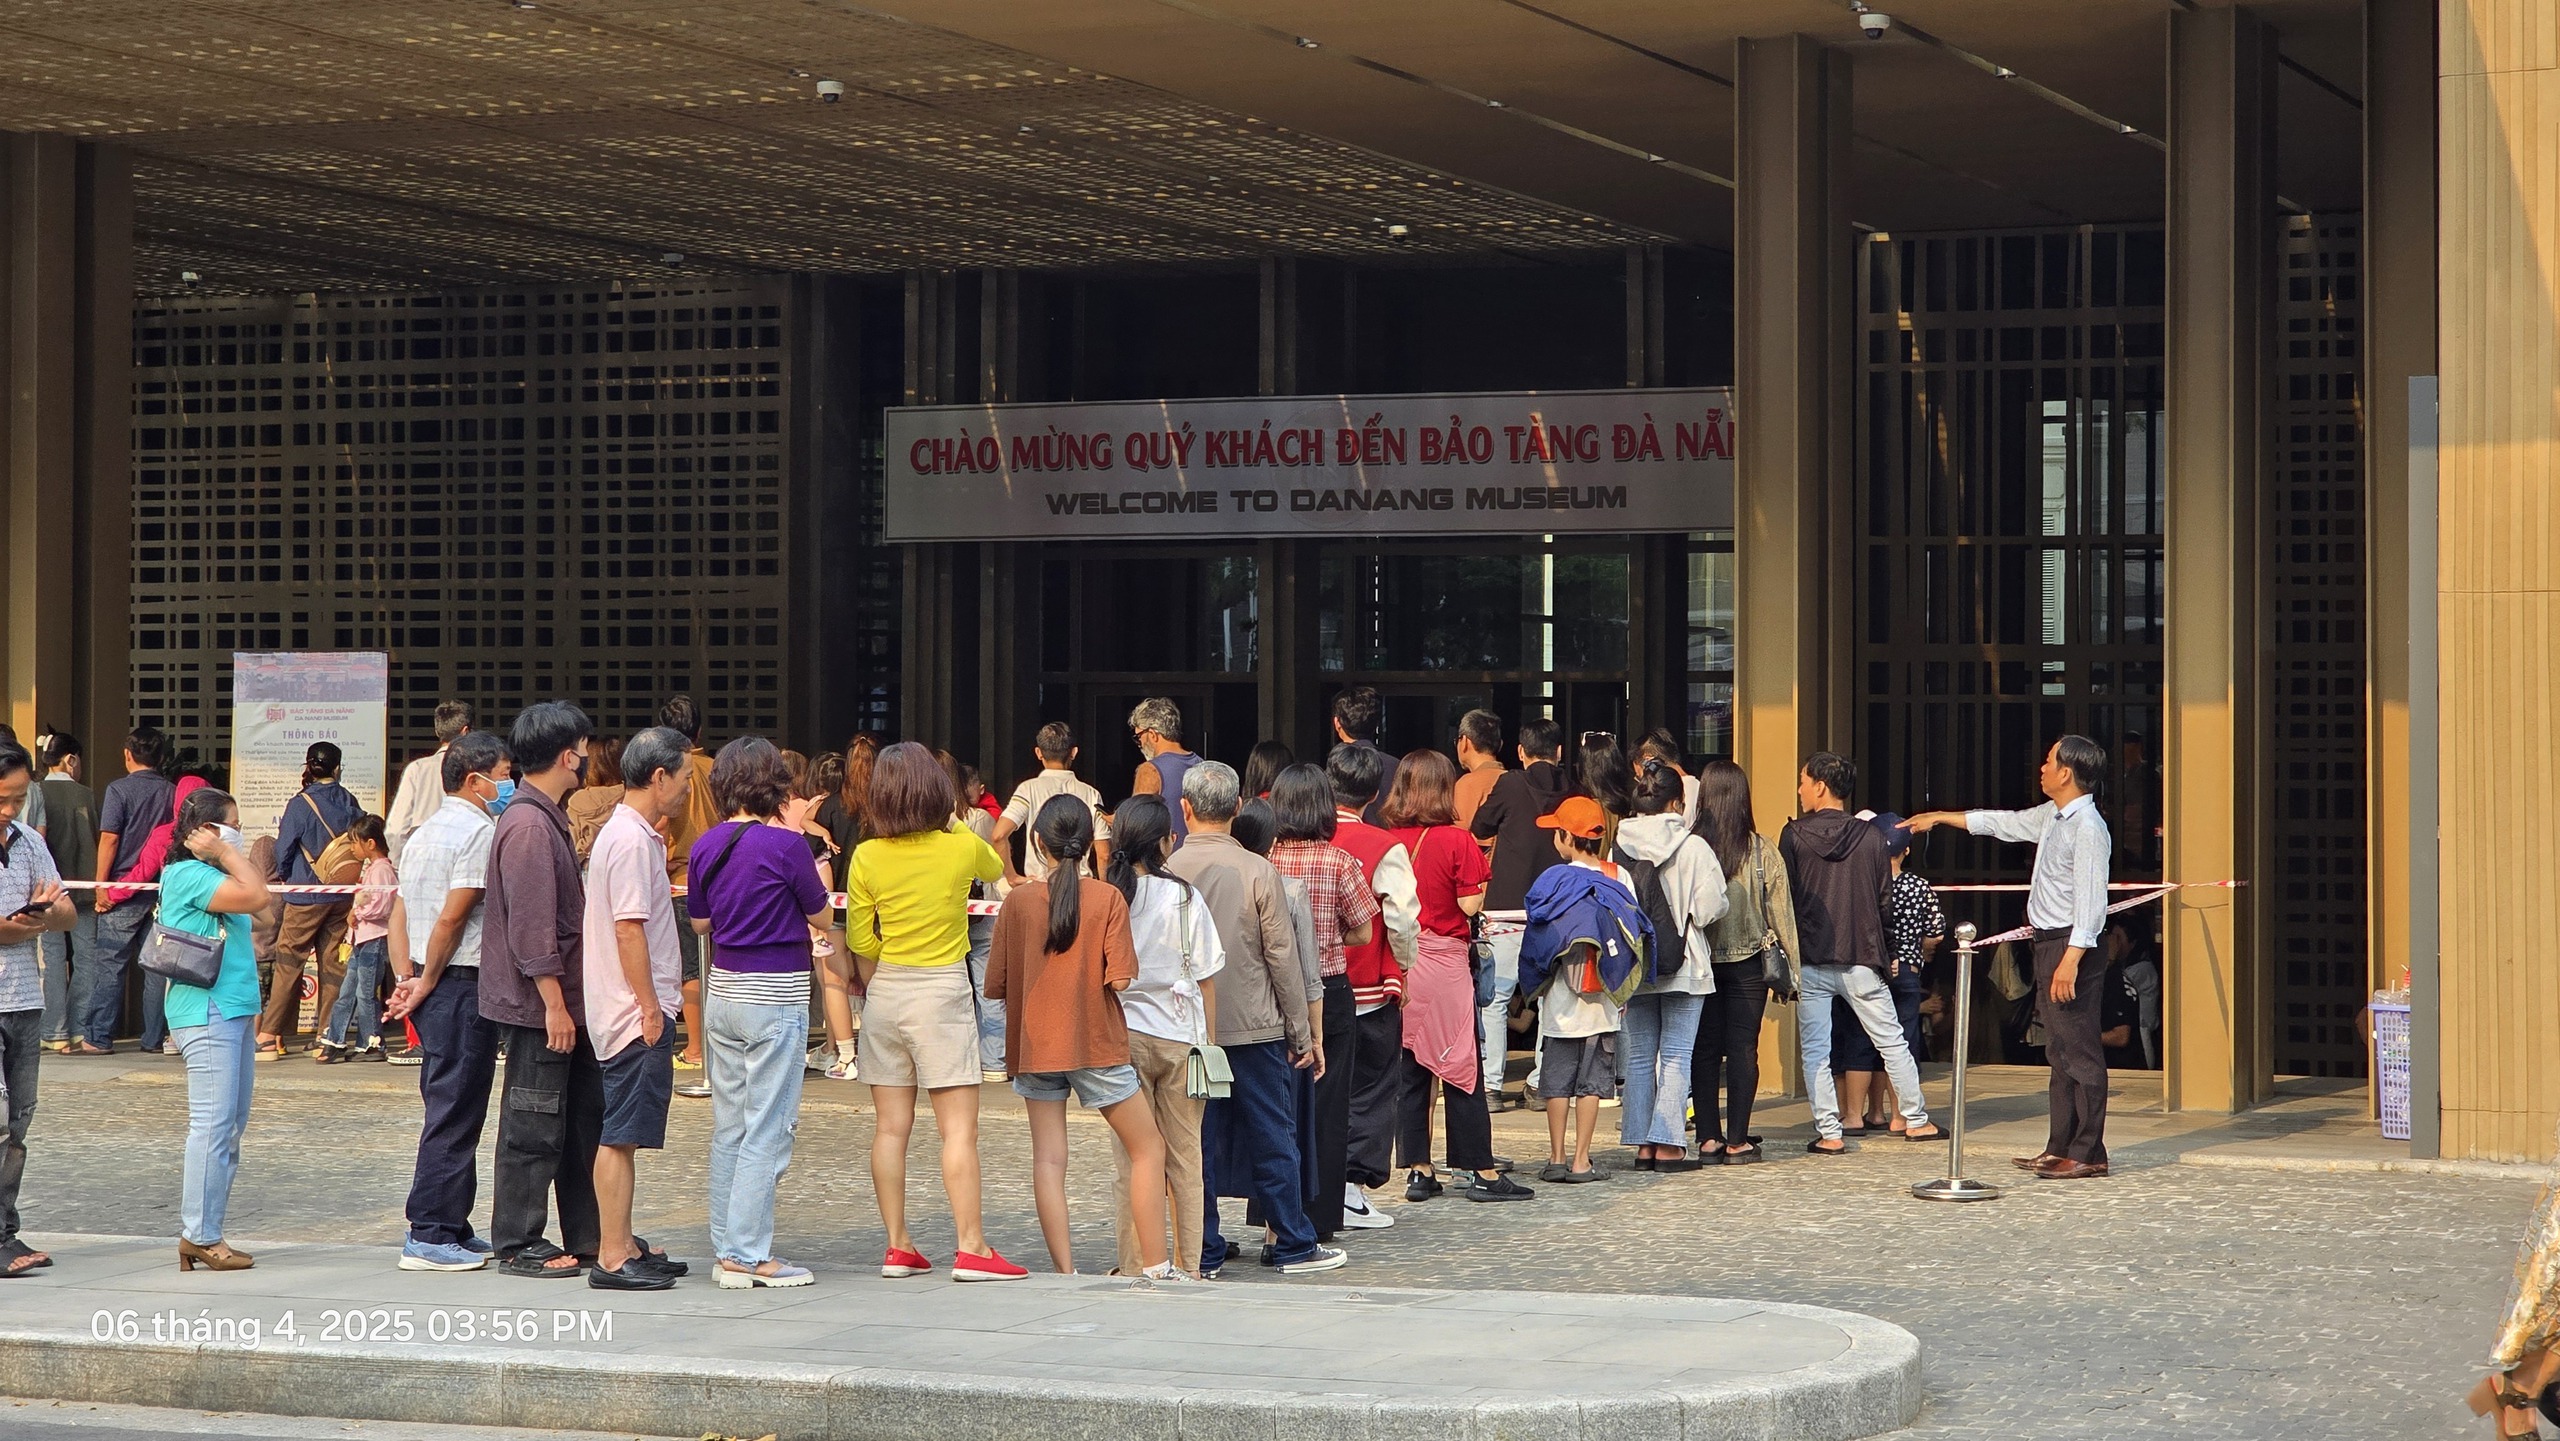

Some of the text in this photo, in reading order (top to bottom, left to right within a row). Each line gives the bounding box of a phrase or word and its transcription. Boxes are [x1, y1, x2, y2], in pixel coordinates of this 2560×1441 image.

[911, 428, 1002, 472] CHÀO
[1011, 424, 1112, 469] MỪNG
[1125, 421, 1196, 470] QUÝ
[1206, 418, 1324, 466] KHÁCH
[1336, 412, 1406, 464] ĐẾN
[1419, 415, 1494, 463] BẢO
[1504, 413, 1600, 462] TÀNG
[1612, 412, 1664, 461] ĐÀ
[1045, 486, 1627, 515] WELCOME TO DANANG MUSEUM
[282, 727, 338, 739] THÔNG BÁO
